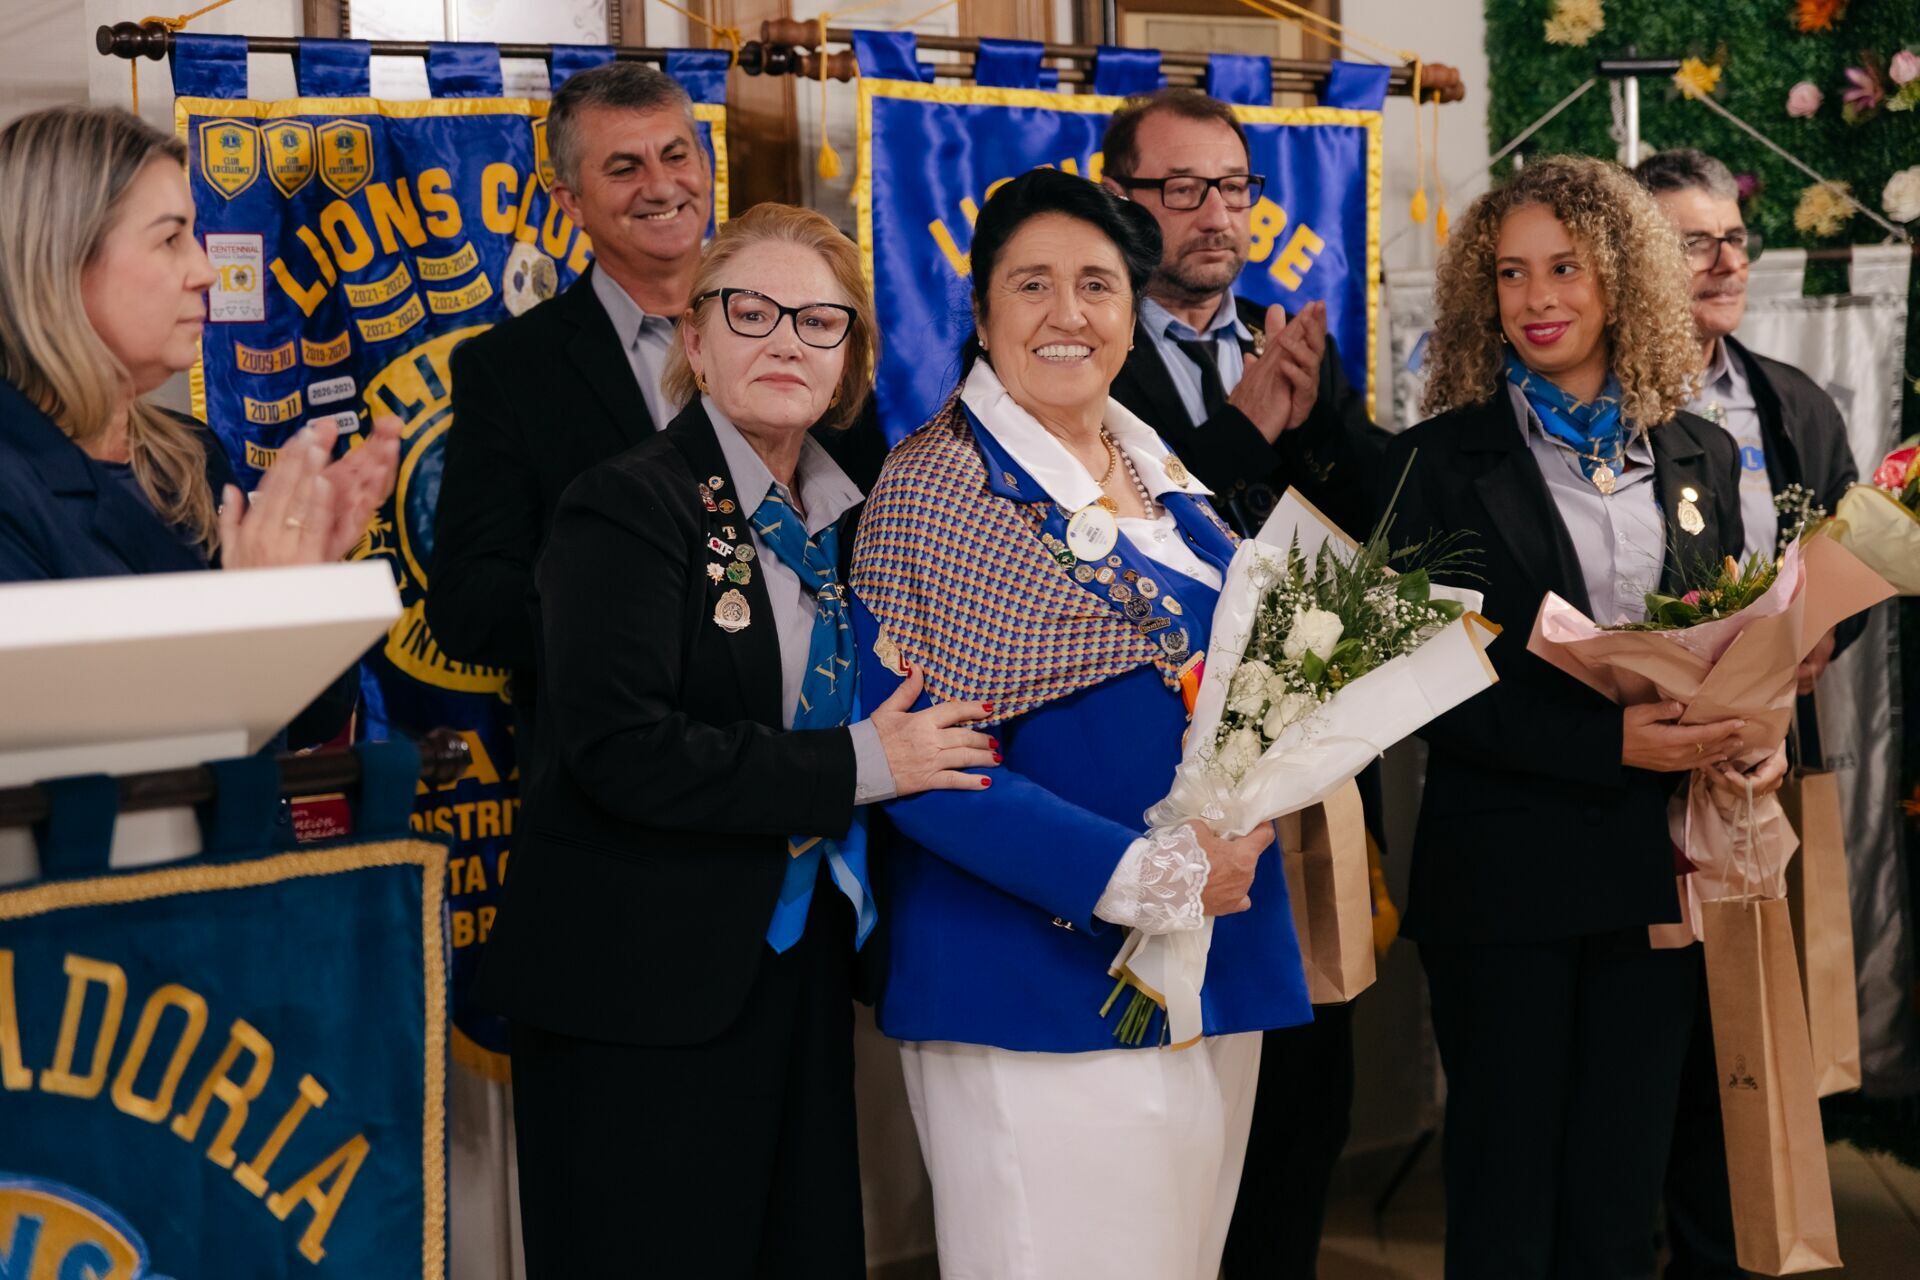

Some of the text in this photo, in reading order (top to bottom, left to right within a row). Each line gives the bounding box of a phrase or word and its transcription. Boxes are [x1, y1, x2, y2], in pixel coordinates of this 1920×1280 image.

[210, 246, 260, 254] CENTENNIAL
[269, 167, 463, 318] LIONS
[241, 349, 292, 372] 2009-10
[251, 398, 298, 425] 2010-11
